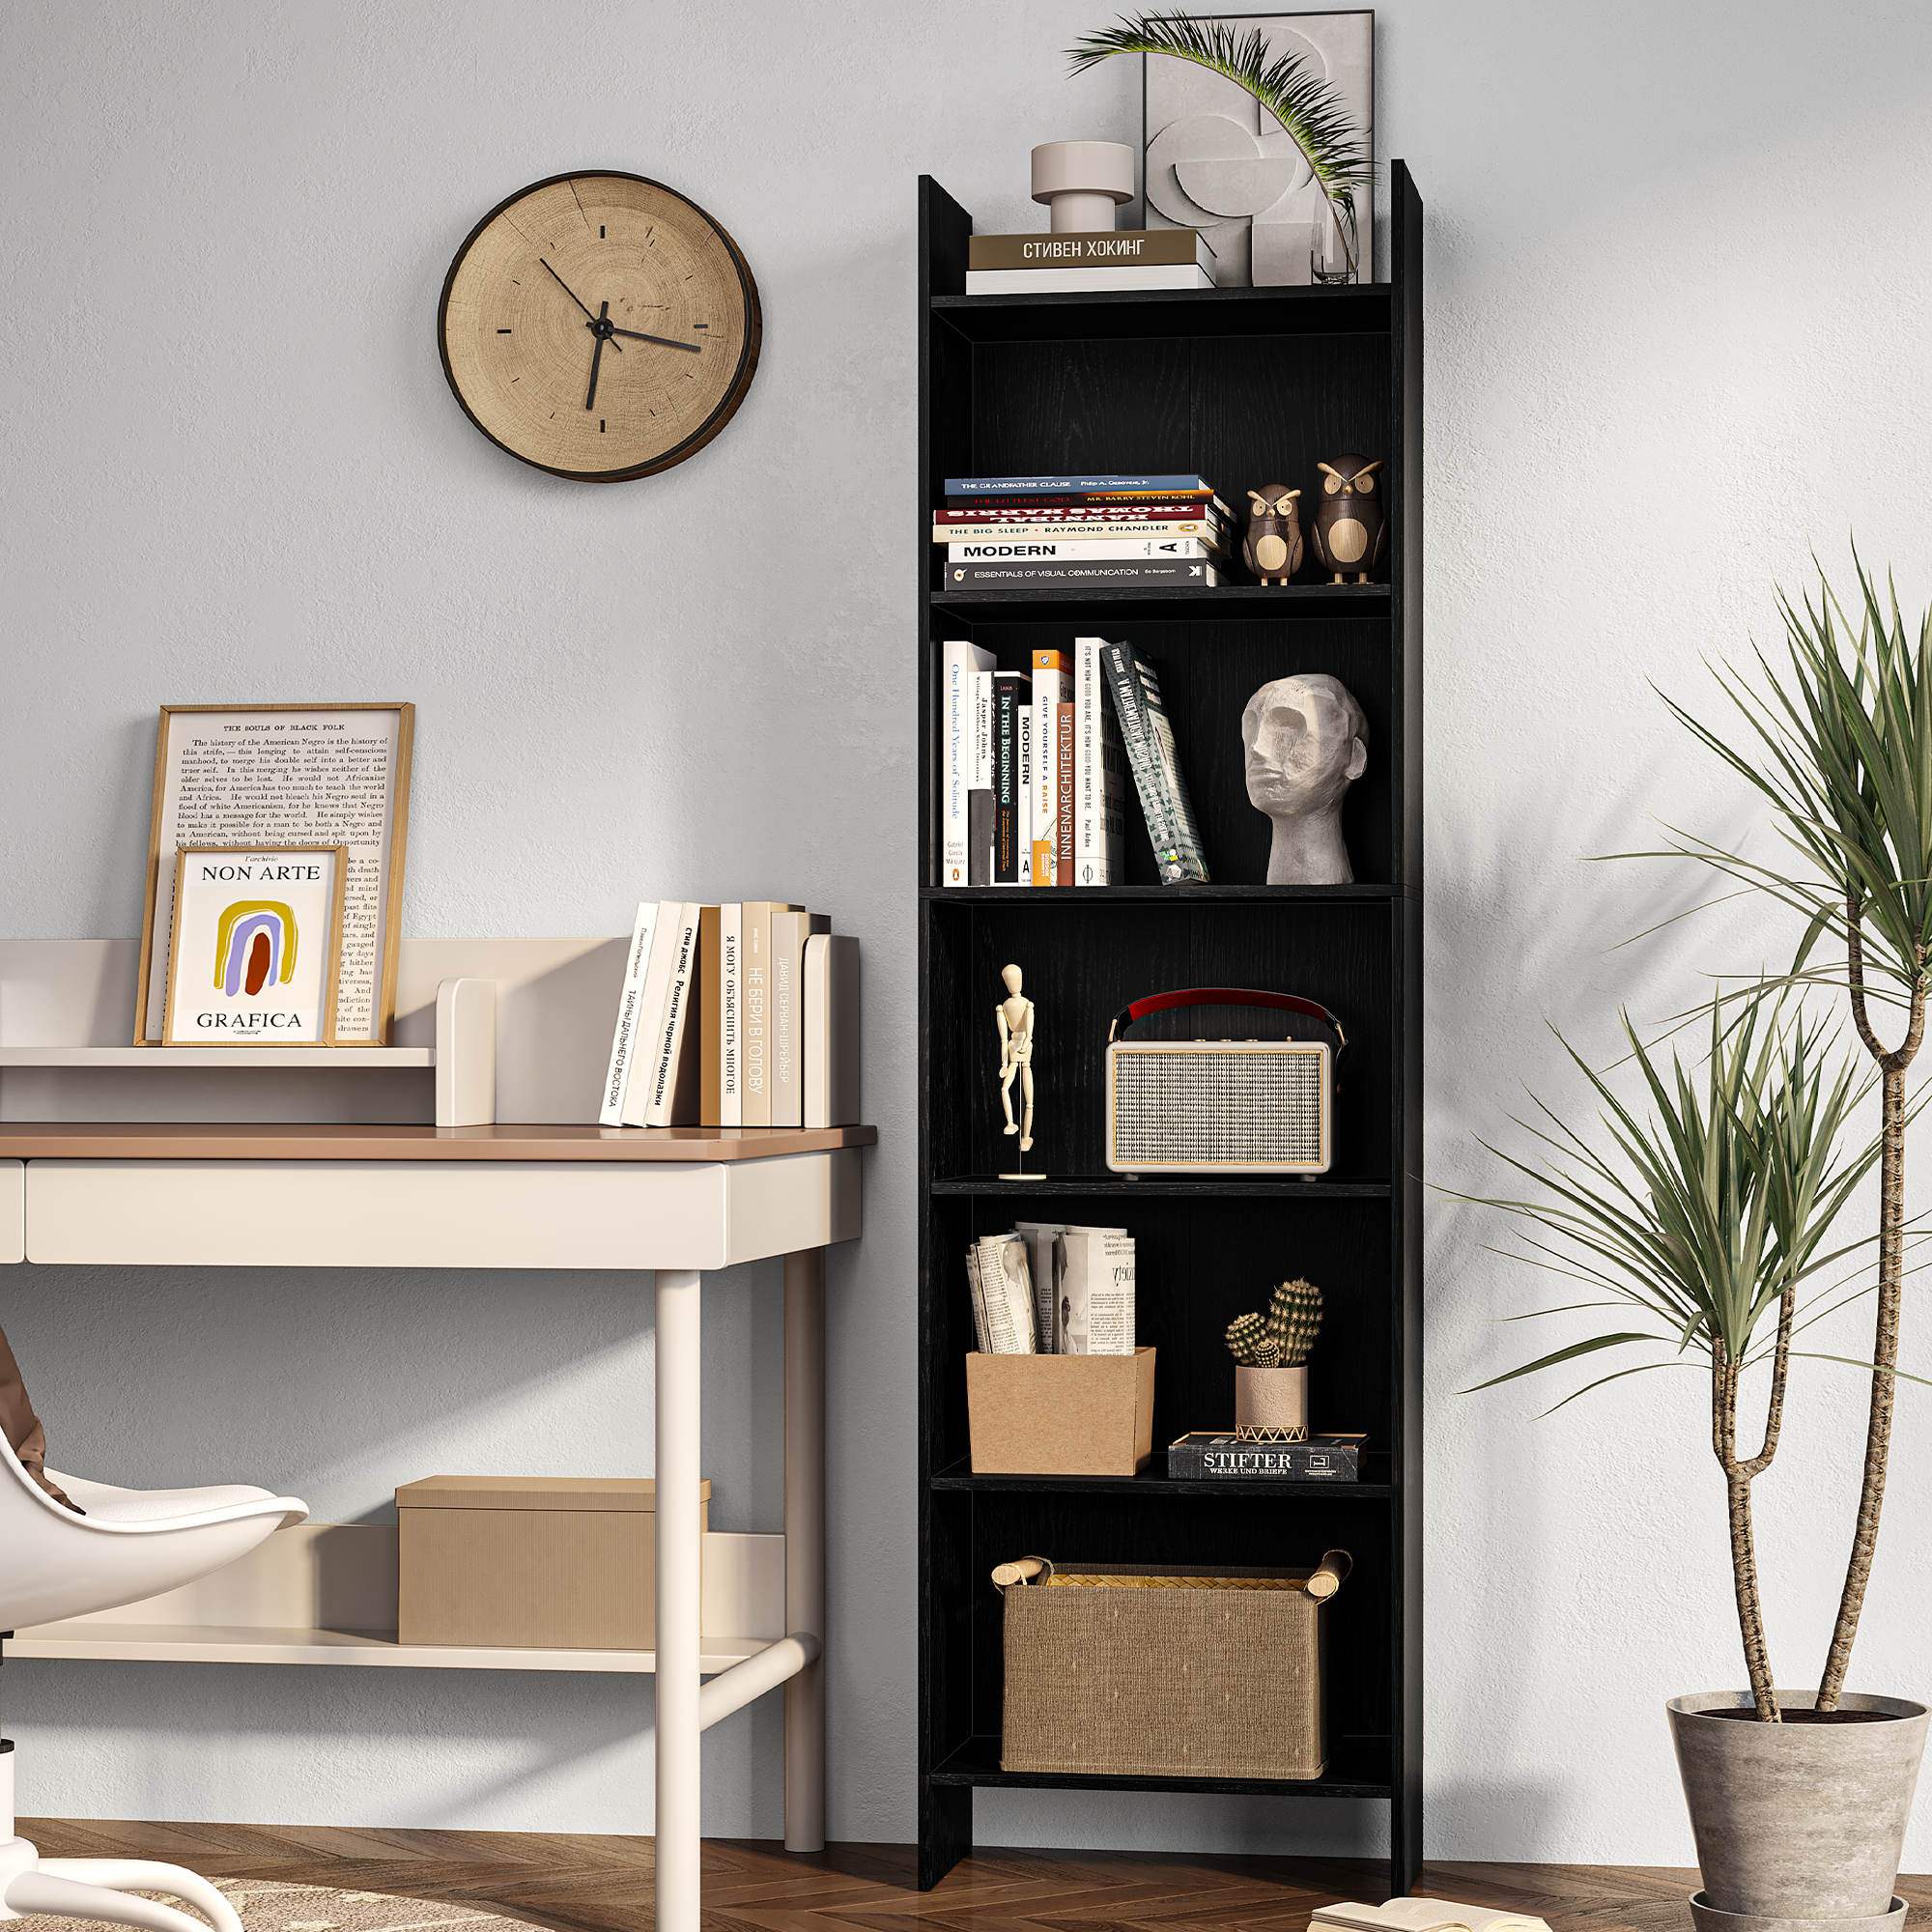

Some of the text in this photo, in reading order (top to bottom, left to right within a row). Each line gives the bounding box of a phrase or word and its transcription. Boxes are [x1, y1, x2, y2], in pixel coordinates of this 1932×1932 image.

[1023, 239, 1145, 259] СТИВЕН ХОКИНГ
[947, 506, 1193, 517] THOMAS HARRIS
[990, 514, 1148, 523] HANNIBAL
[964, 545, 1056, 557] MODERN
[1001, 696, 1011, 709] IN
[1001, 712, 1011, 735] THE
[210, 739, 236, 748] history
[302, 738, 325, 747] Negro
[351, 738, 378, 746] history
[258, 748, 286, 756] longing
[951, 664, 960, 819] One Hundred Years of Solitude
[1001, 738, 1011, 804] BEGINNING
[1060, 715, 1071, 860] INNENARCHITEKTUR
[202, 866, 320, 881] NON ARTE
[353, 913, 376, 921] Egypt
[347, 941, 374, 949] gauged
[726, 946, 735, 976] МОГУ
[669, 980, 684, 1019] Религия
[196, 1013, 303, 1028] GRAFICA
[726, 979, 735, 1045] ОБЪЯСНИТЬ
[778, 957, 790, 1083] ДАВИД СЕРВАН-ШРЕЙБЕР
[663, 1020, 676, 1054] черной
[749, 967, 763, 1095] НЕ БЕРИ В ГОЛОВУ
[616, 1021, 631, 1066] ДАЛЬНЕГО
[726, 1048, 735, 1094] МНОГОЕ
[608, 1067, 622, 1107] ВОСТОКА
[1204, 1452, 1292, 1469] STIFTER
